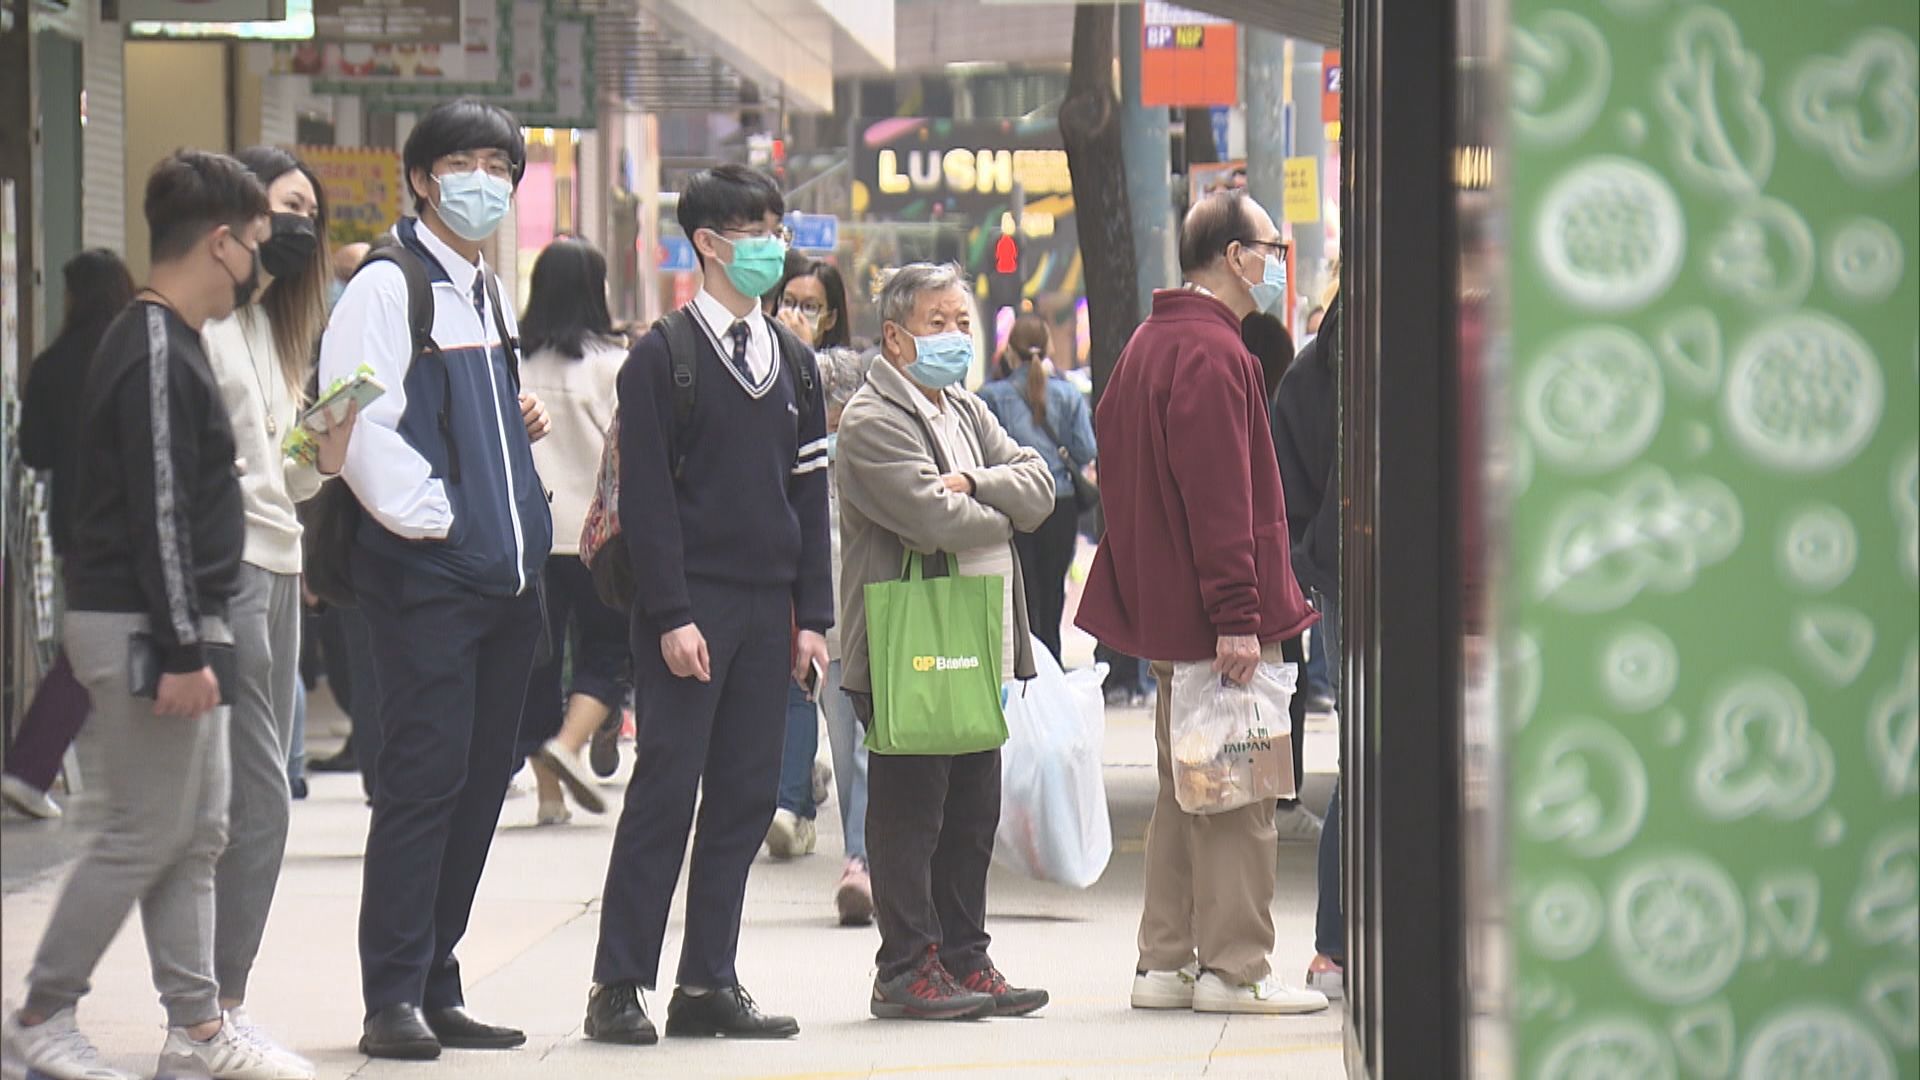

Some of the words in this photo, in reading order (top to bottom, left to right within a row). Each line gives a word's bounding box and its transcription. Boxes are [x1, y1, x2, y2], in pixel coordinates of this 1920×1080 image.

[879, 148, 1013, 193] LUSH
[912, 656, 935, 671] GP
[1224, 740, 1271, 754] TAIPAN
